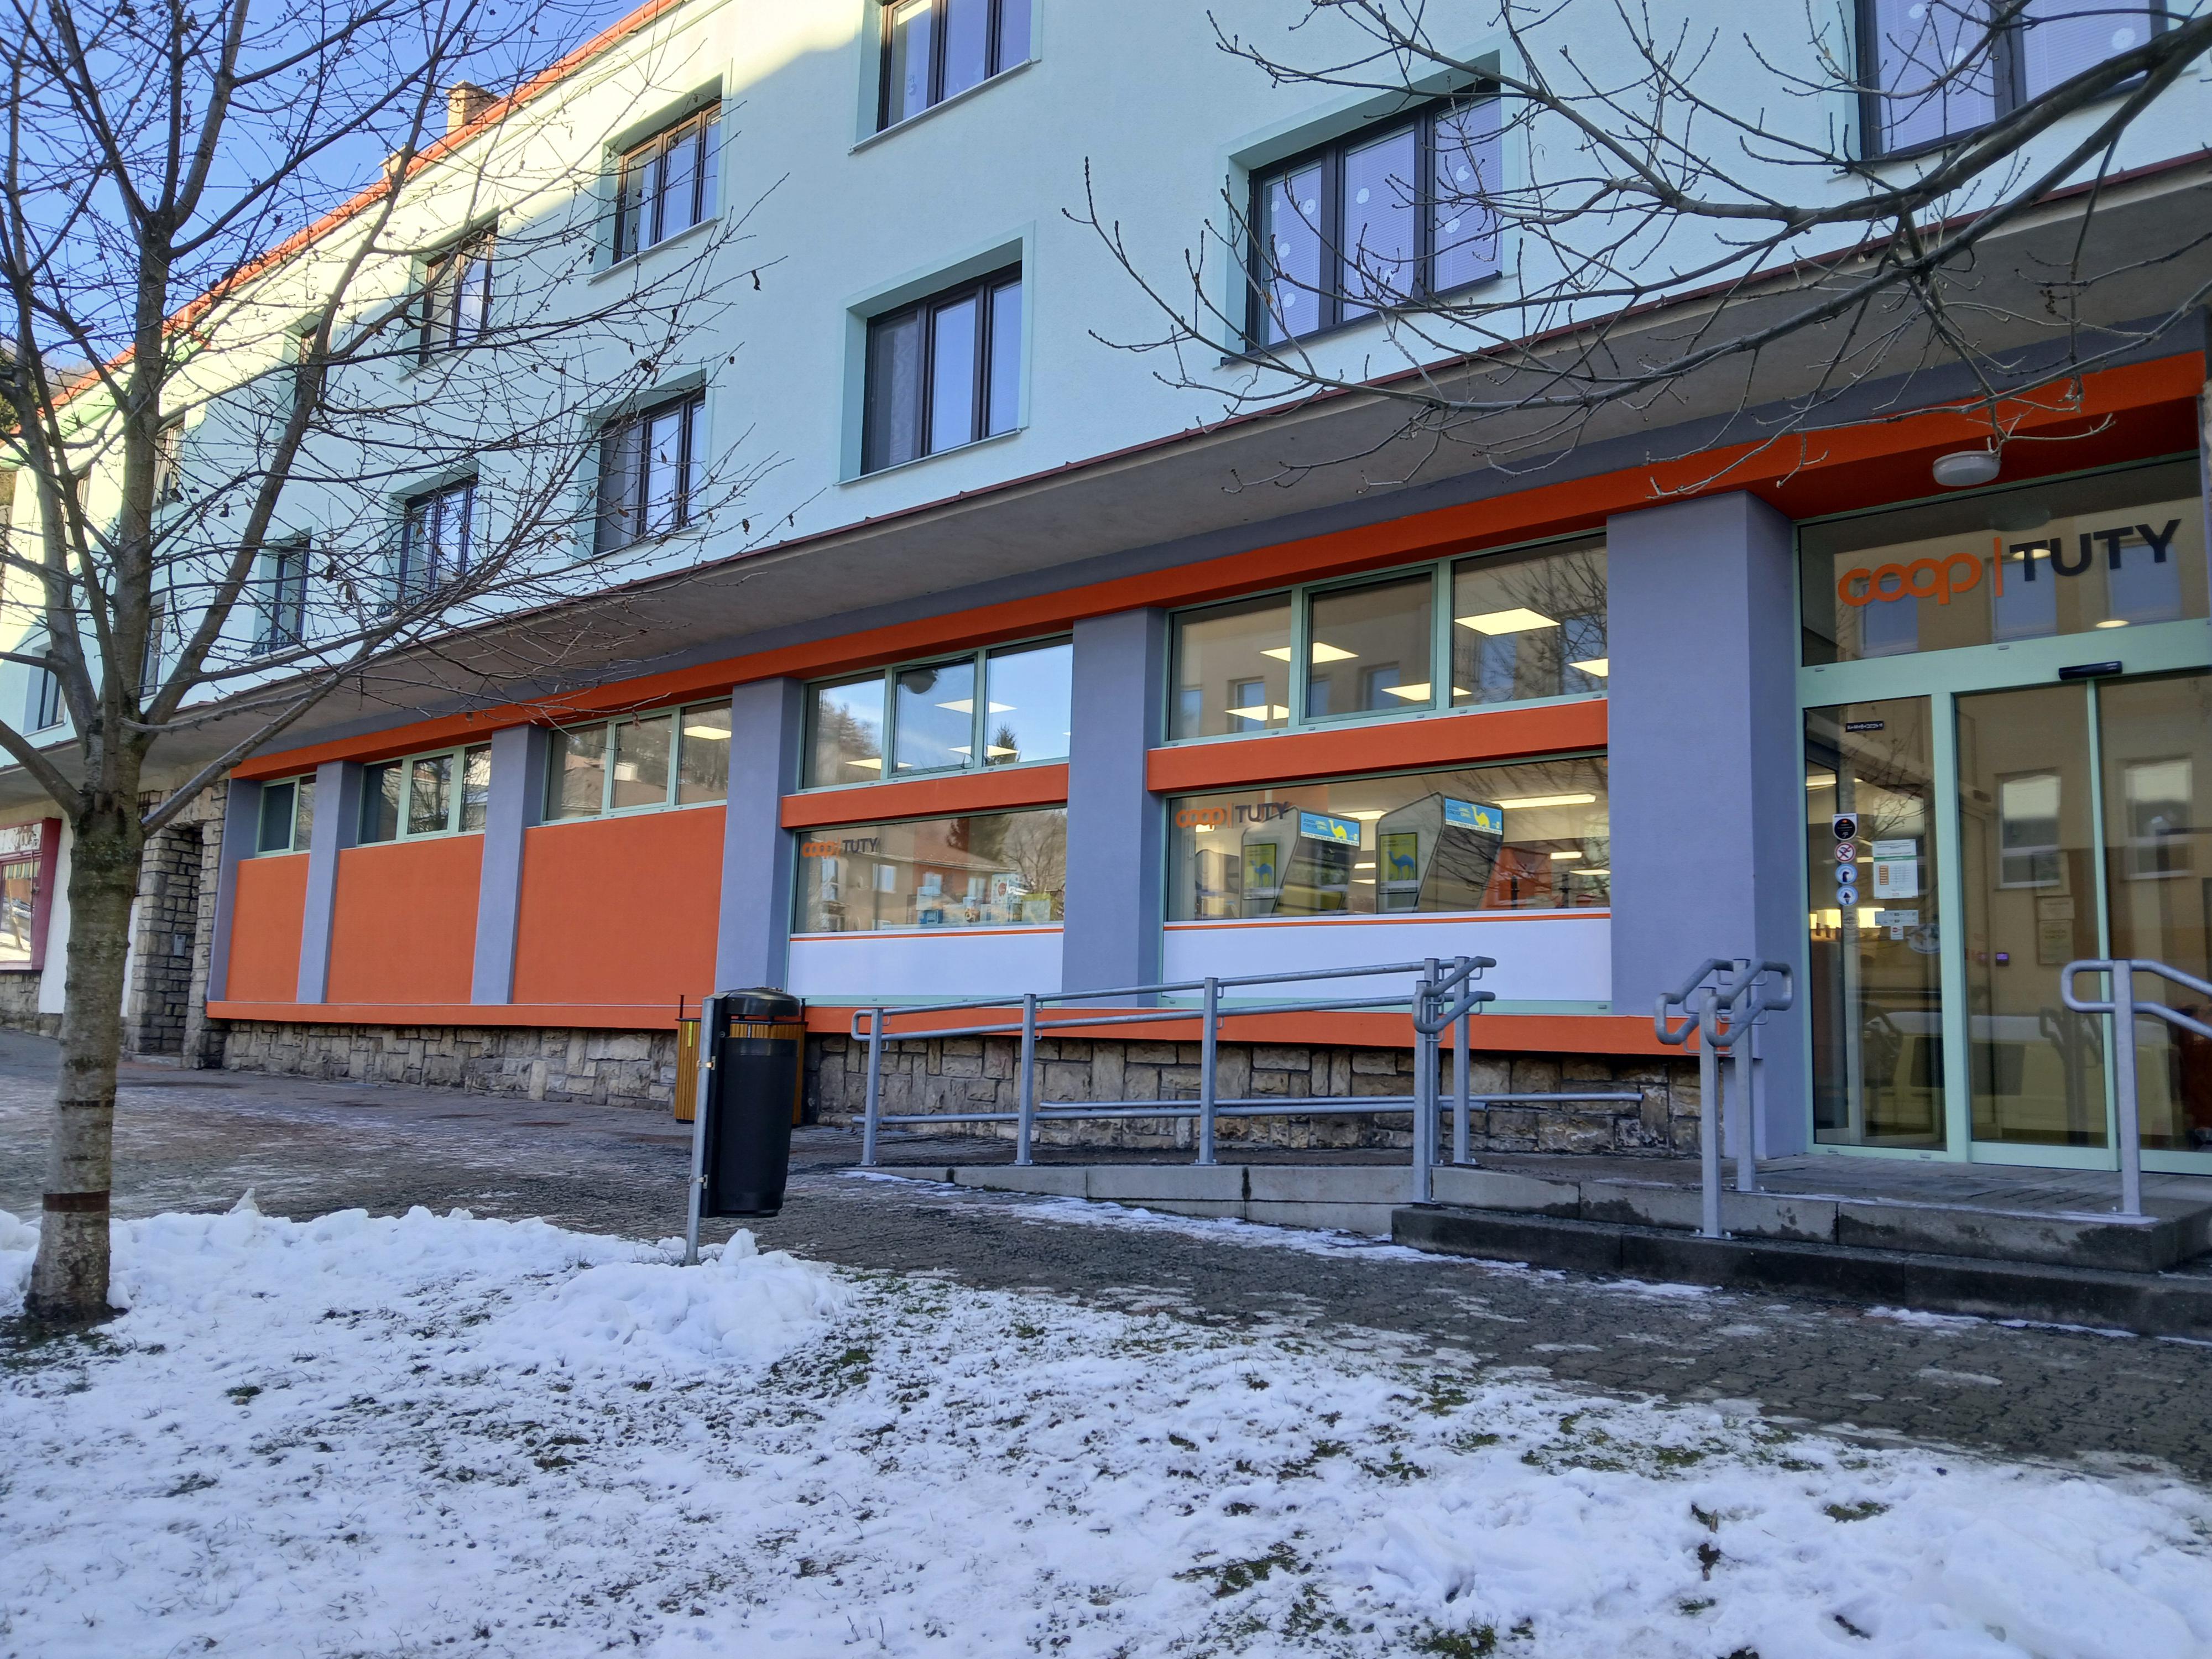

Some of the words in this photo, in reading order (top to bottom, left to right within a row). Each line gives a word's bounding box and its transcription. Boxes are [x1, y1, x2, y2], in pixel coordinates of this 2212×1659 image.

[1838, 553, 1983, 606] coop
[2010, 518, 2182, 581] TUTY
[1235, 801, 1289, 823] TUTY
[842, 837, 878, 853] TUTY
